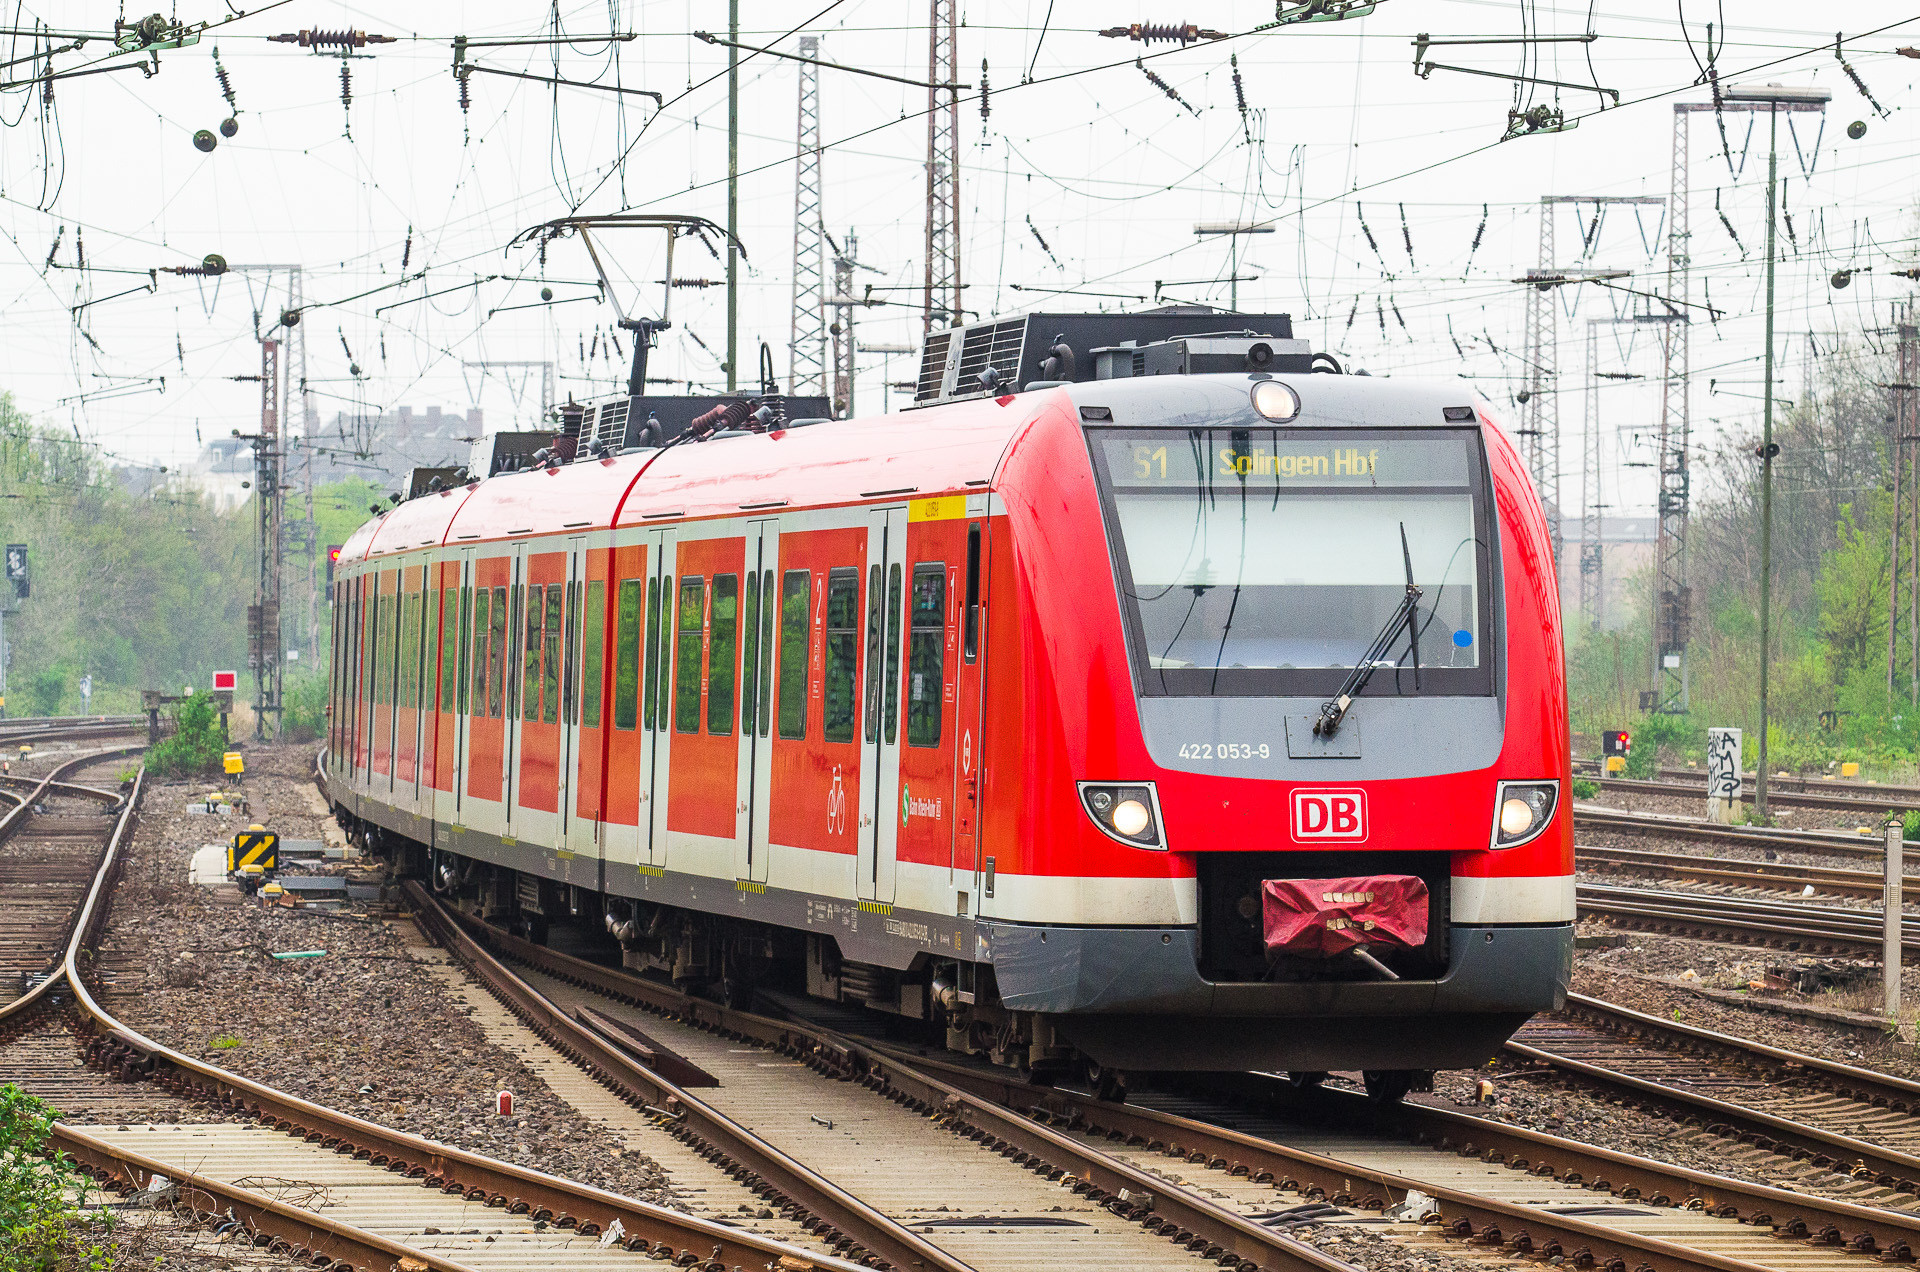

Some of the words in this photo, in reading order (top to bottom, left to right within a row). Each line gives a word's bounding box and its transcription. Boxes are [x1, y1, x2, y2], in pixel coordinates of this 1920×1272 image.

[1133, 446, 1167, 479] S1
[1219, 448, 1328, 478] Solingen
[1334, 448, 1379, 476] Hbf
[815, 577, 822, 625] 2
[1178, 743, 1213, 759] 422
[1216, 743, 1270, 759] 053-9
[1299, 796, 1360, 835] DB
